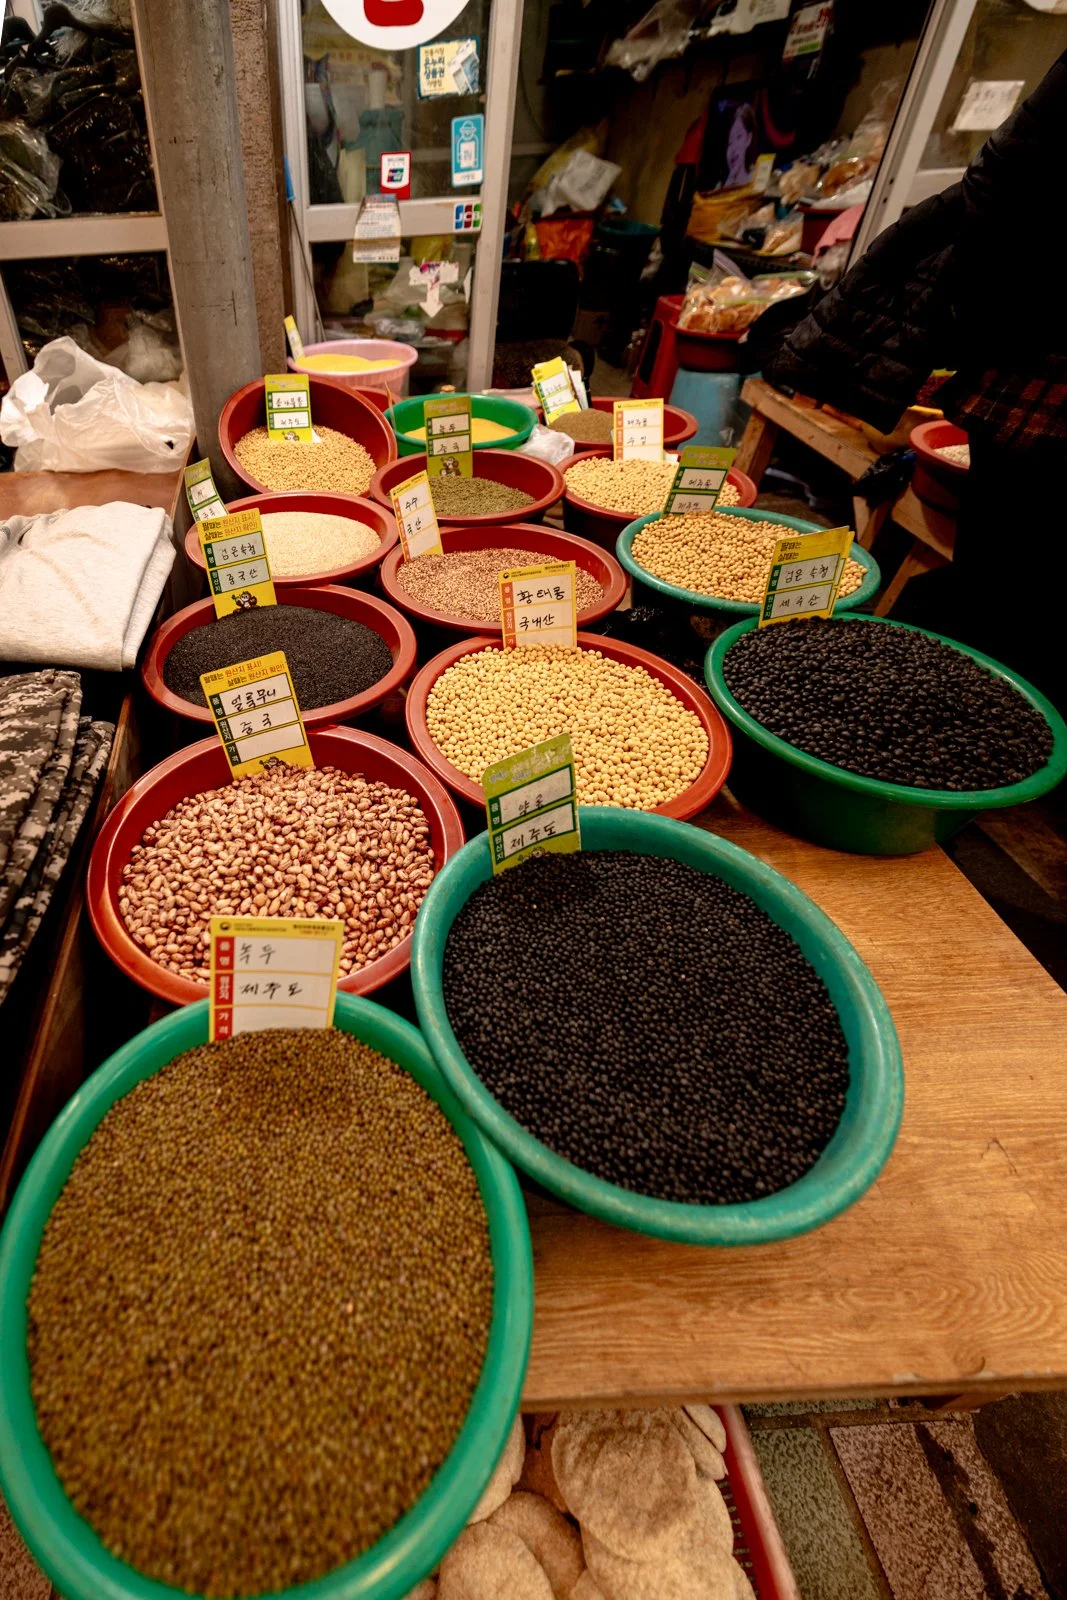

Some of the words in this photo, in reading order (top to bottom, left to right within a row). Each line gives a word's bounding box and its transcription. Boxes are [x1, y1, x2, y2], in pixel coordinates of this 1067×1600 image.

[455, 203, 482, 230] JCB
[226, 568, 259, 586] 중국산
[519, 614, 555, 631] 국내산
[510, 820, 556, 849] 제주도
[239, 942, 276, 965] 녹두
[240, 982, 303, 1000] 제주도
